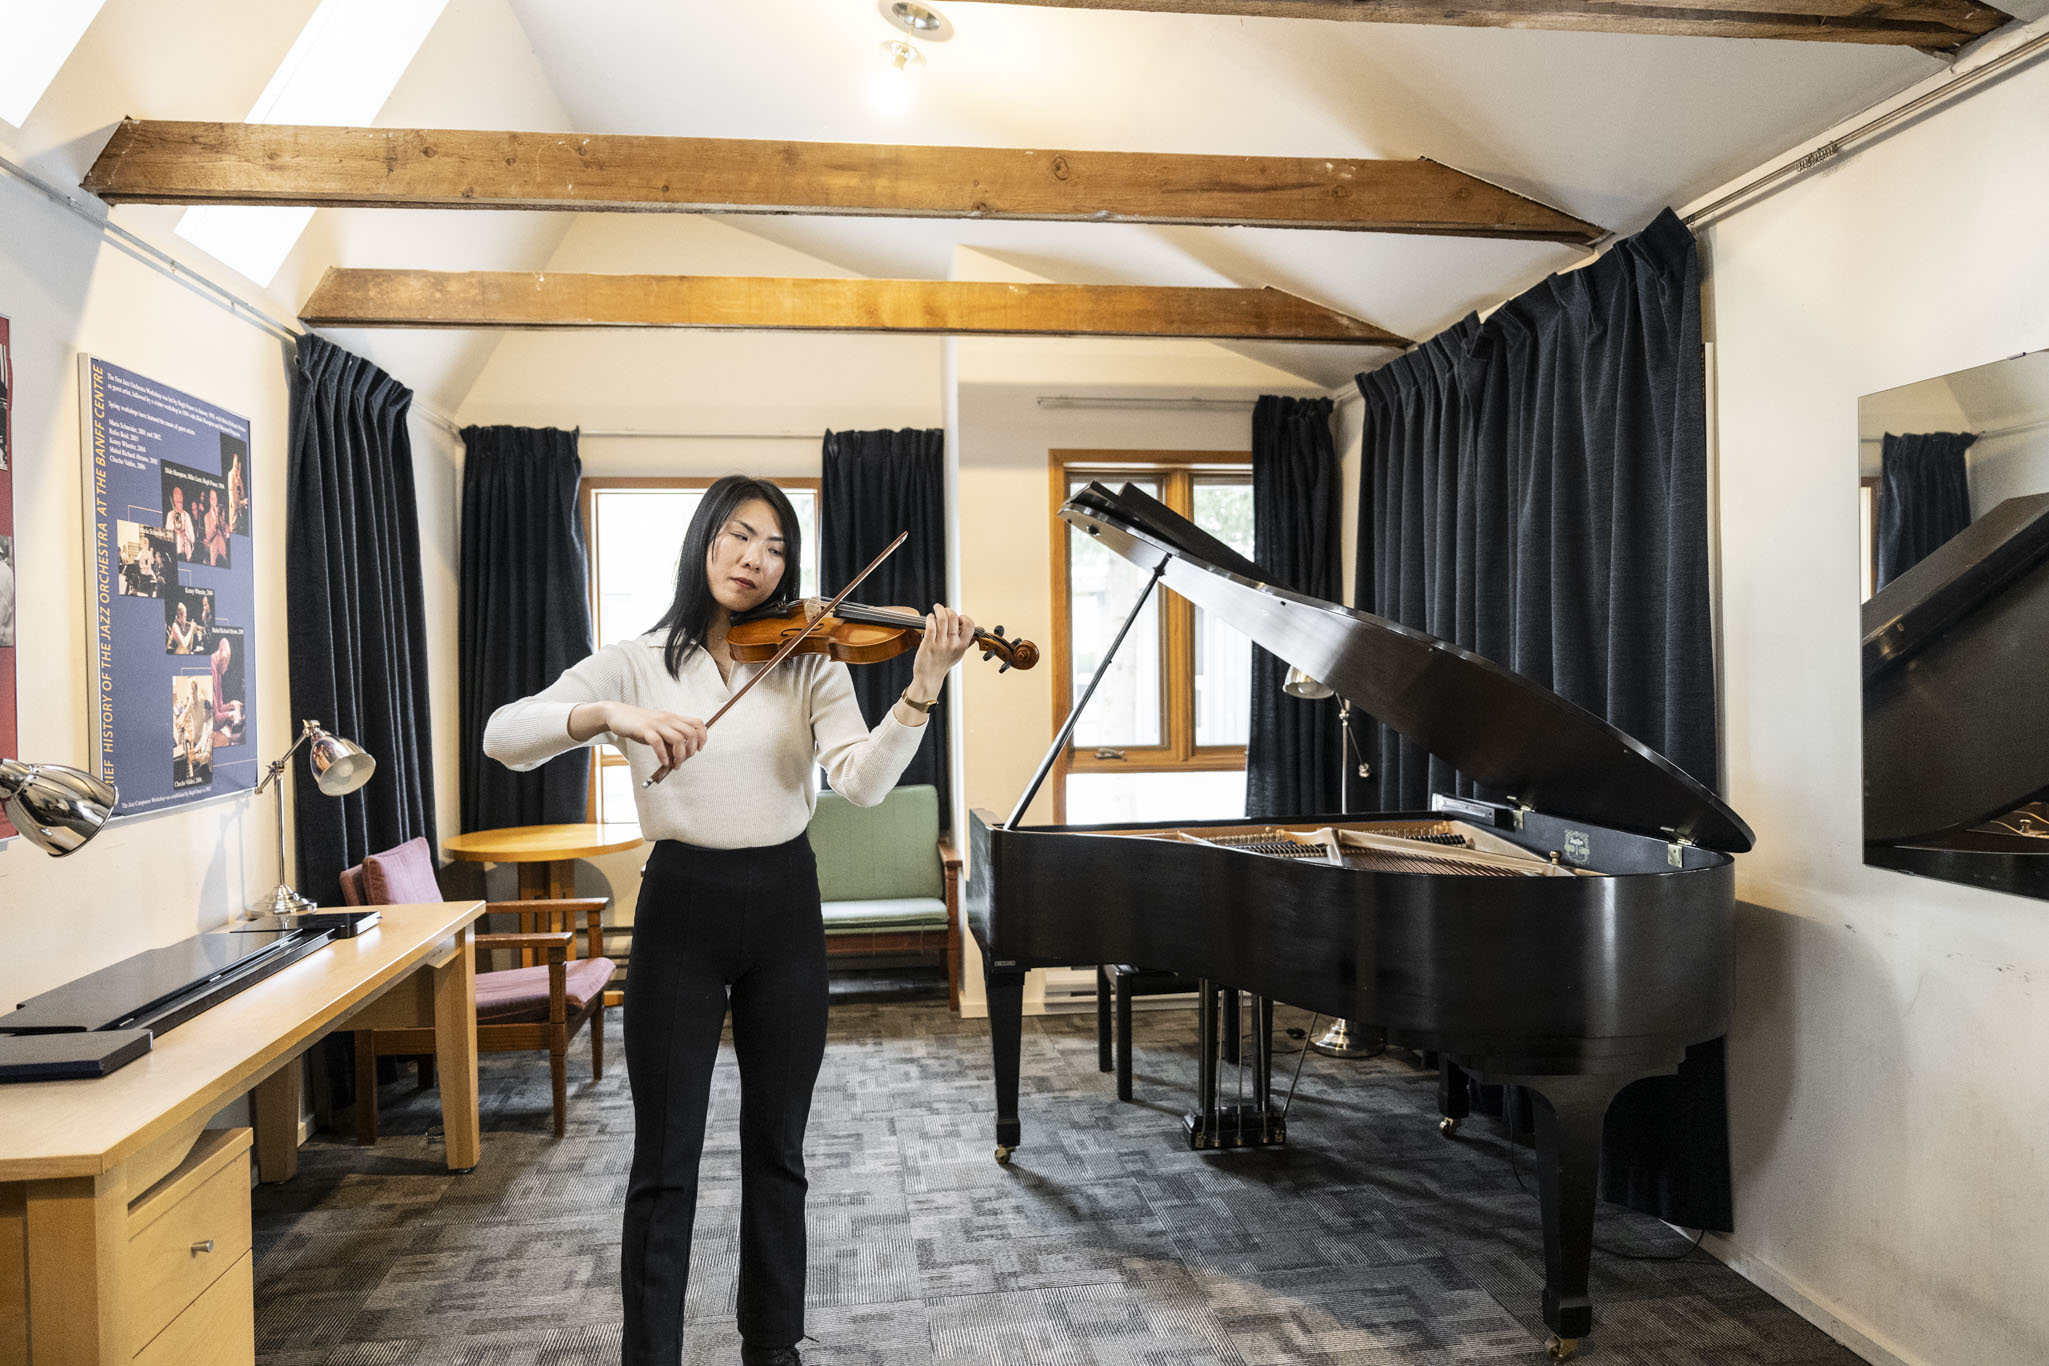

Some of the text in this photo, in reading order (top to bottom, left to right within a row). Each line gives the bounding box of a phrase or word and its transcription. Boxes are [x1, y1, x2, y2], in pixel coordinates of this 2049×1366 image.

[93, 364, 114, 785] RIEF HISTORY OF THE JAZZ ORCHESTRA AT THE BANFF CENTRE
